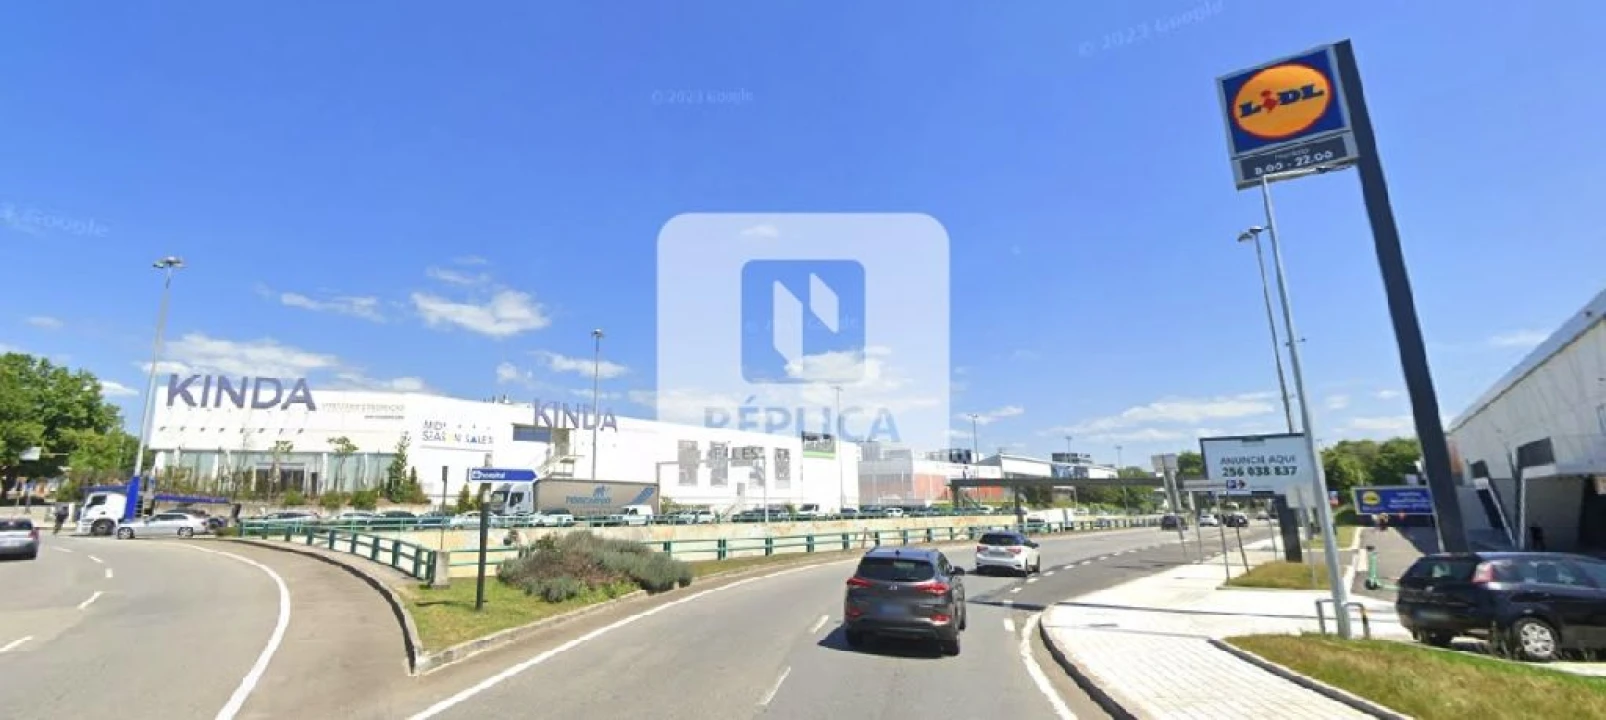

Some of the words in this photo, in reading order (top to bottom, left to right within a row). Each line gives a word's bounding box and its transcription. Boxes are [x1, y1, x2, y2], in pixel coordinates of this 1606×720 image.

[1294, 150, 1334, 168] 22.00
[166, 373, 317, 411] KINDA
[533, 399, 618, 433] KINDA
[1222, 466, 1245, 478] 256
[1247, 466, 1270, 477] 038
[1274, 465, 1298, 476] 837
